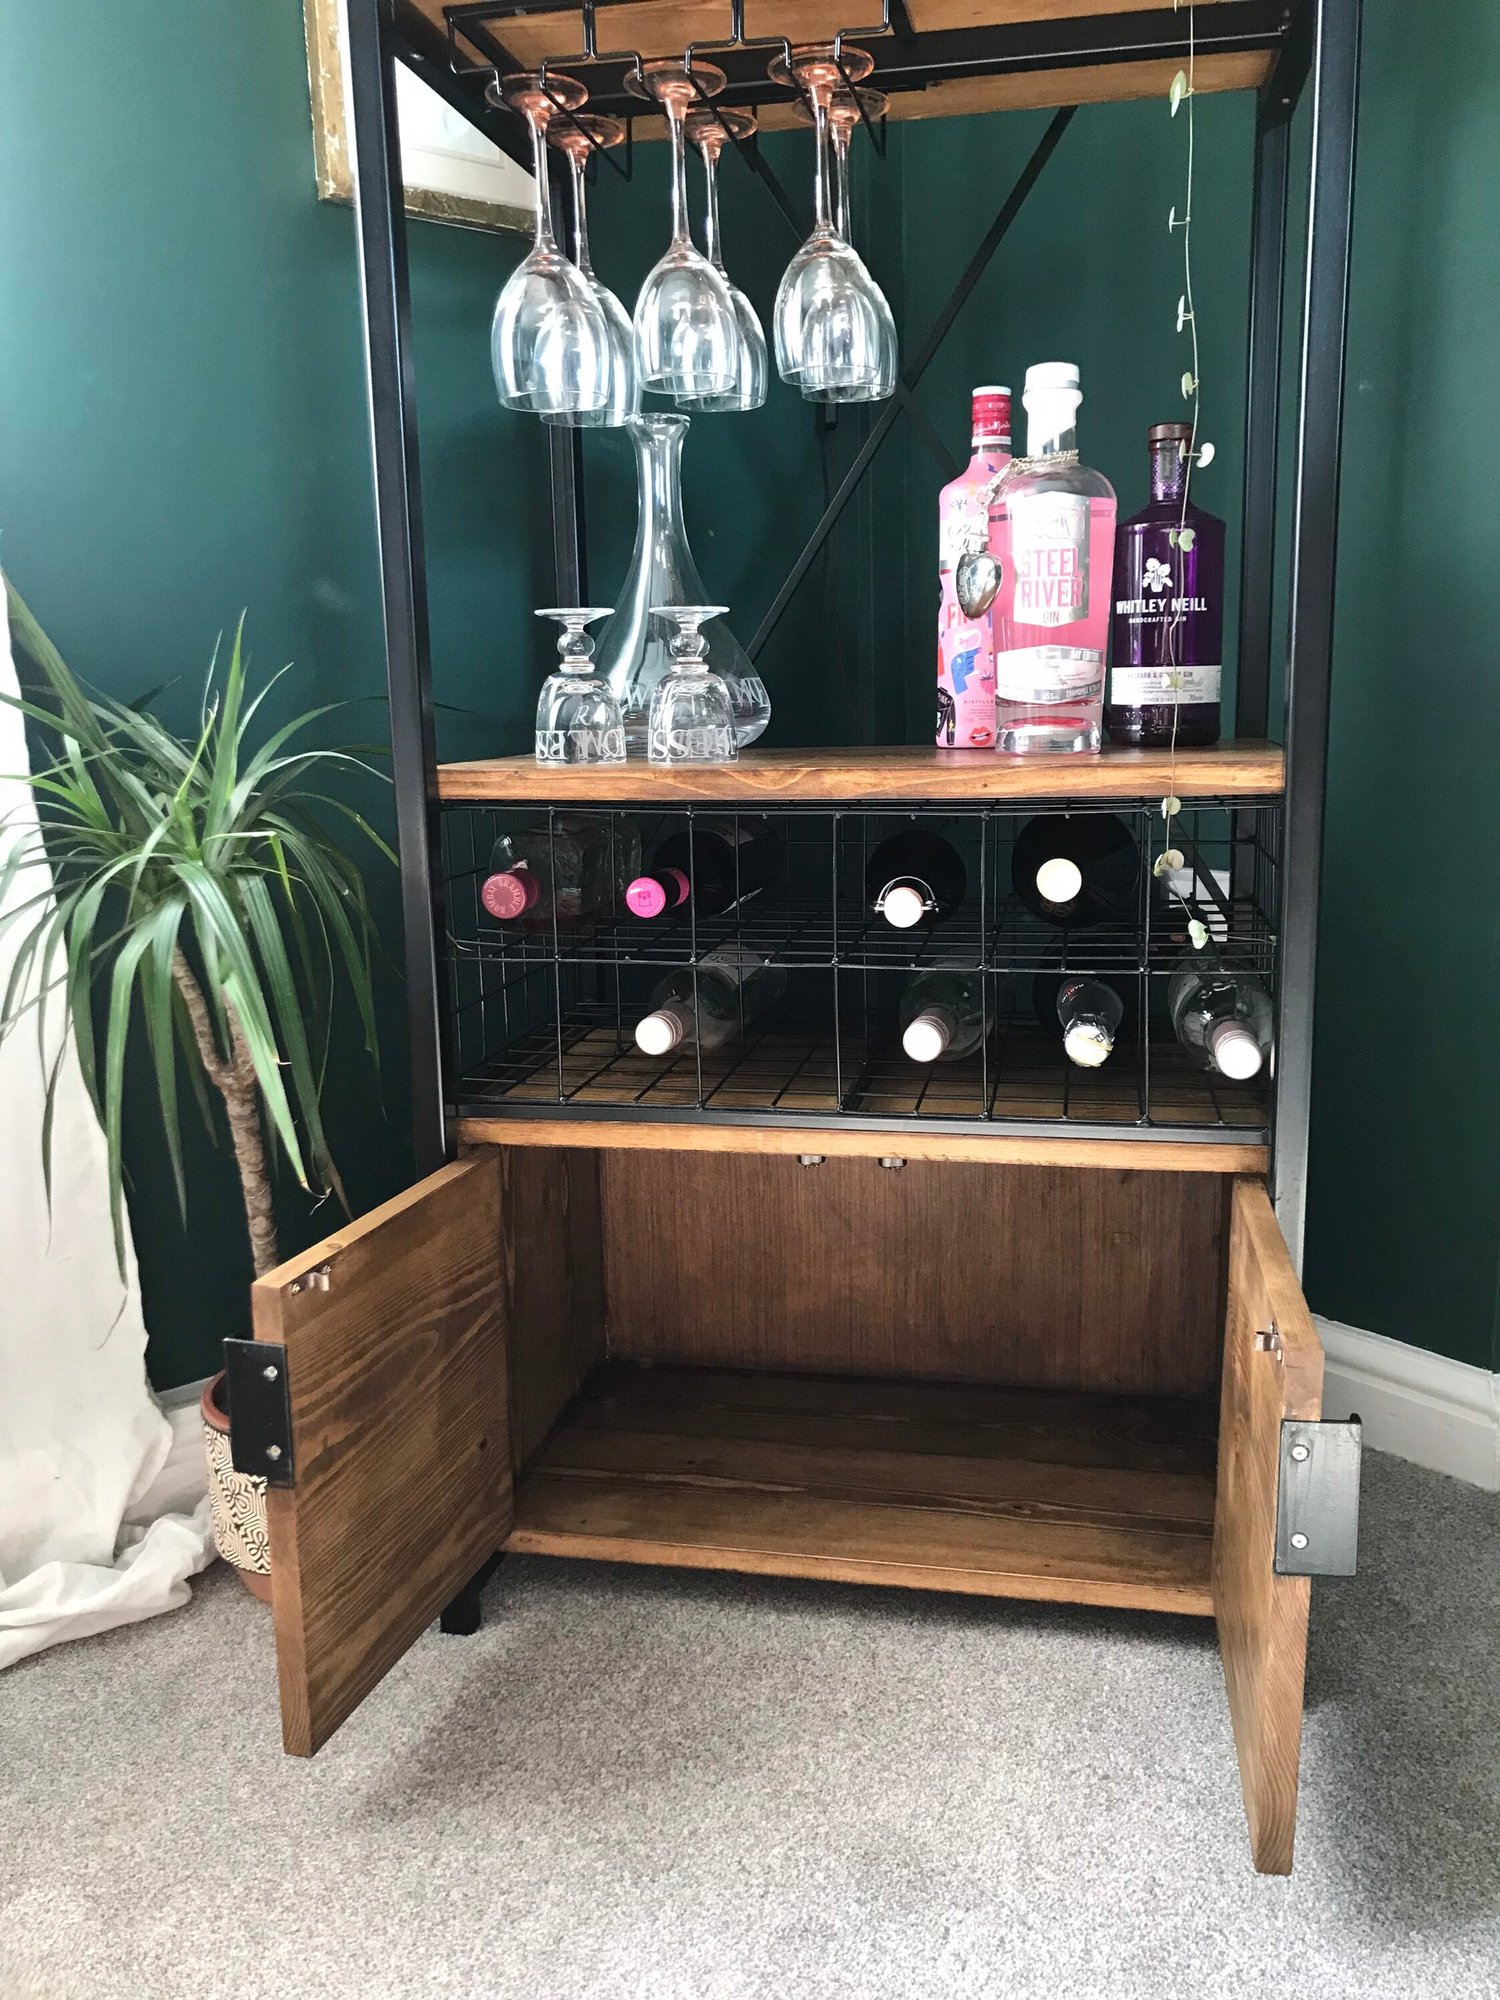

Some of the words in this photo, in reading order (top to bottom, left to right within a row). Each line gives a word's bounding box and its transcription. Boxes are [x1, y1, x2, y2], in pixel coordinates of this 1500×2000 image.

[1021, 547, 1085, 578] STEEL
[1021, 578, 1083, 609] RIVER
[1116, 598, 1167, 614] WHITLEY
[1171, 597, 1208, 612] NEILL
[1043, 610, 1060, 624] GIN
[1128, 616, 1173, 624] HANDCRAFTED
[486, 885, 506, 915] BOMBAY
[498, 879, 521, 912] BRAMBLE
